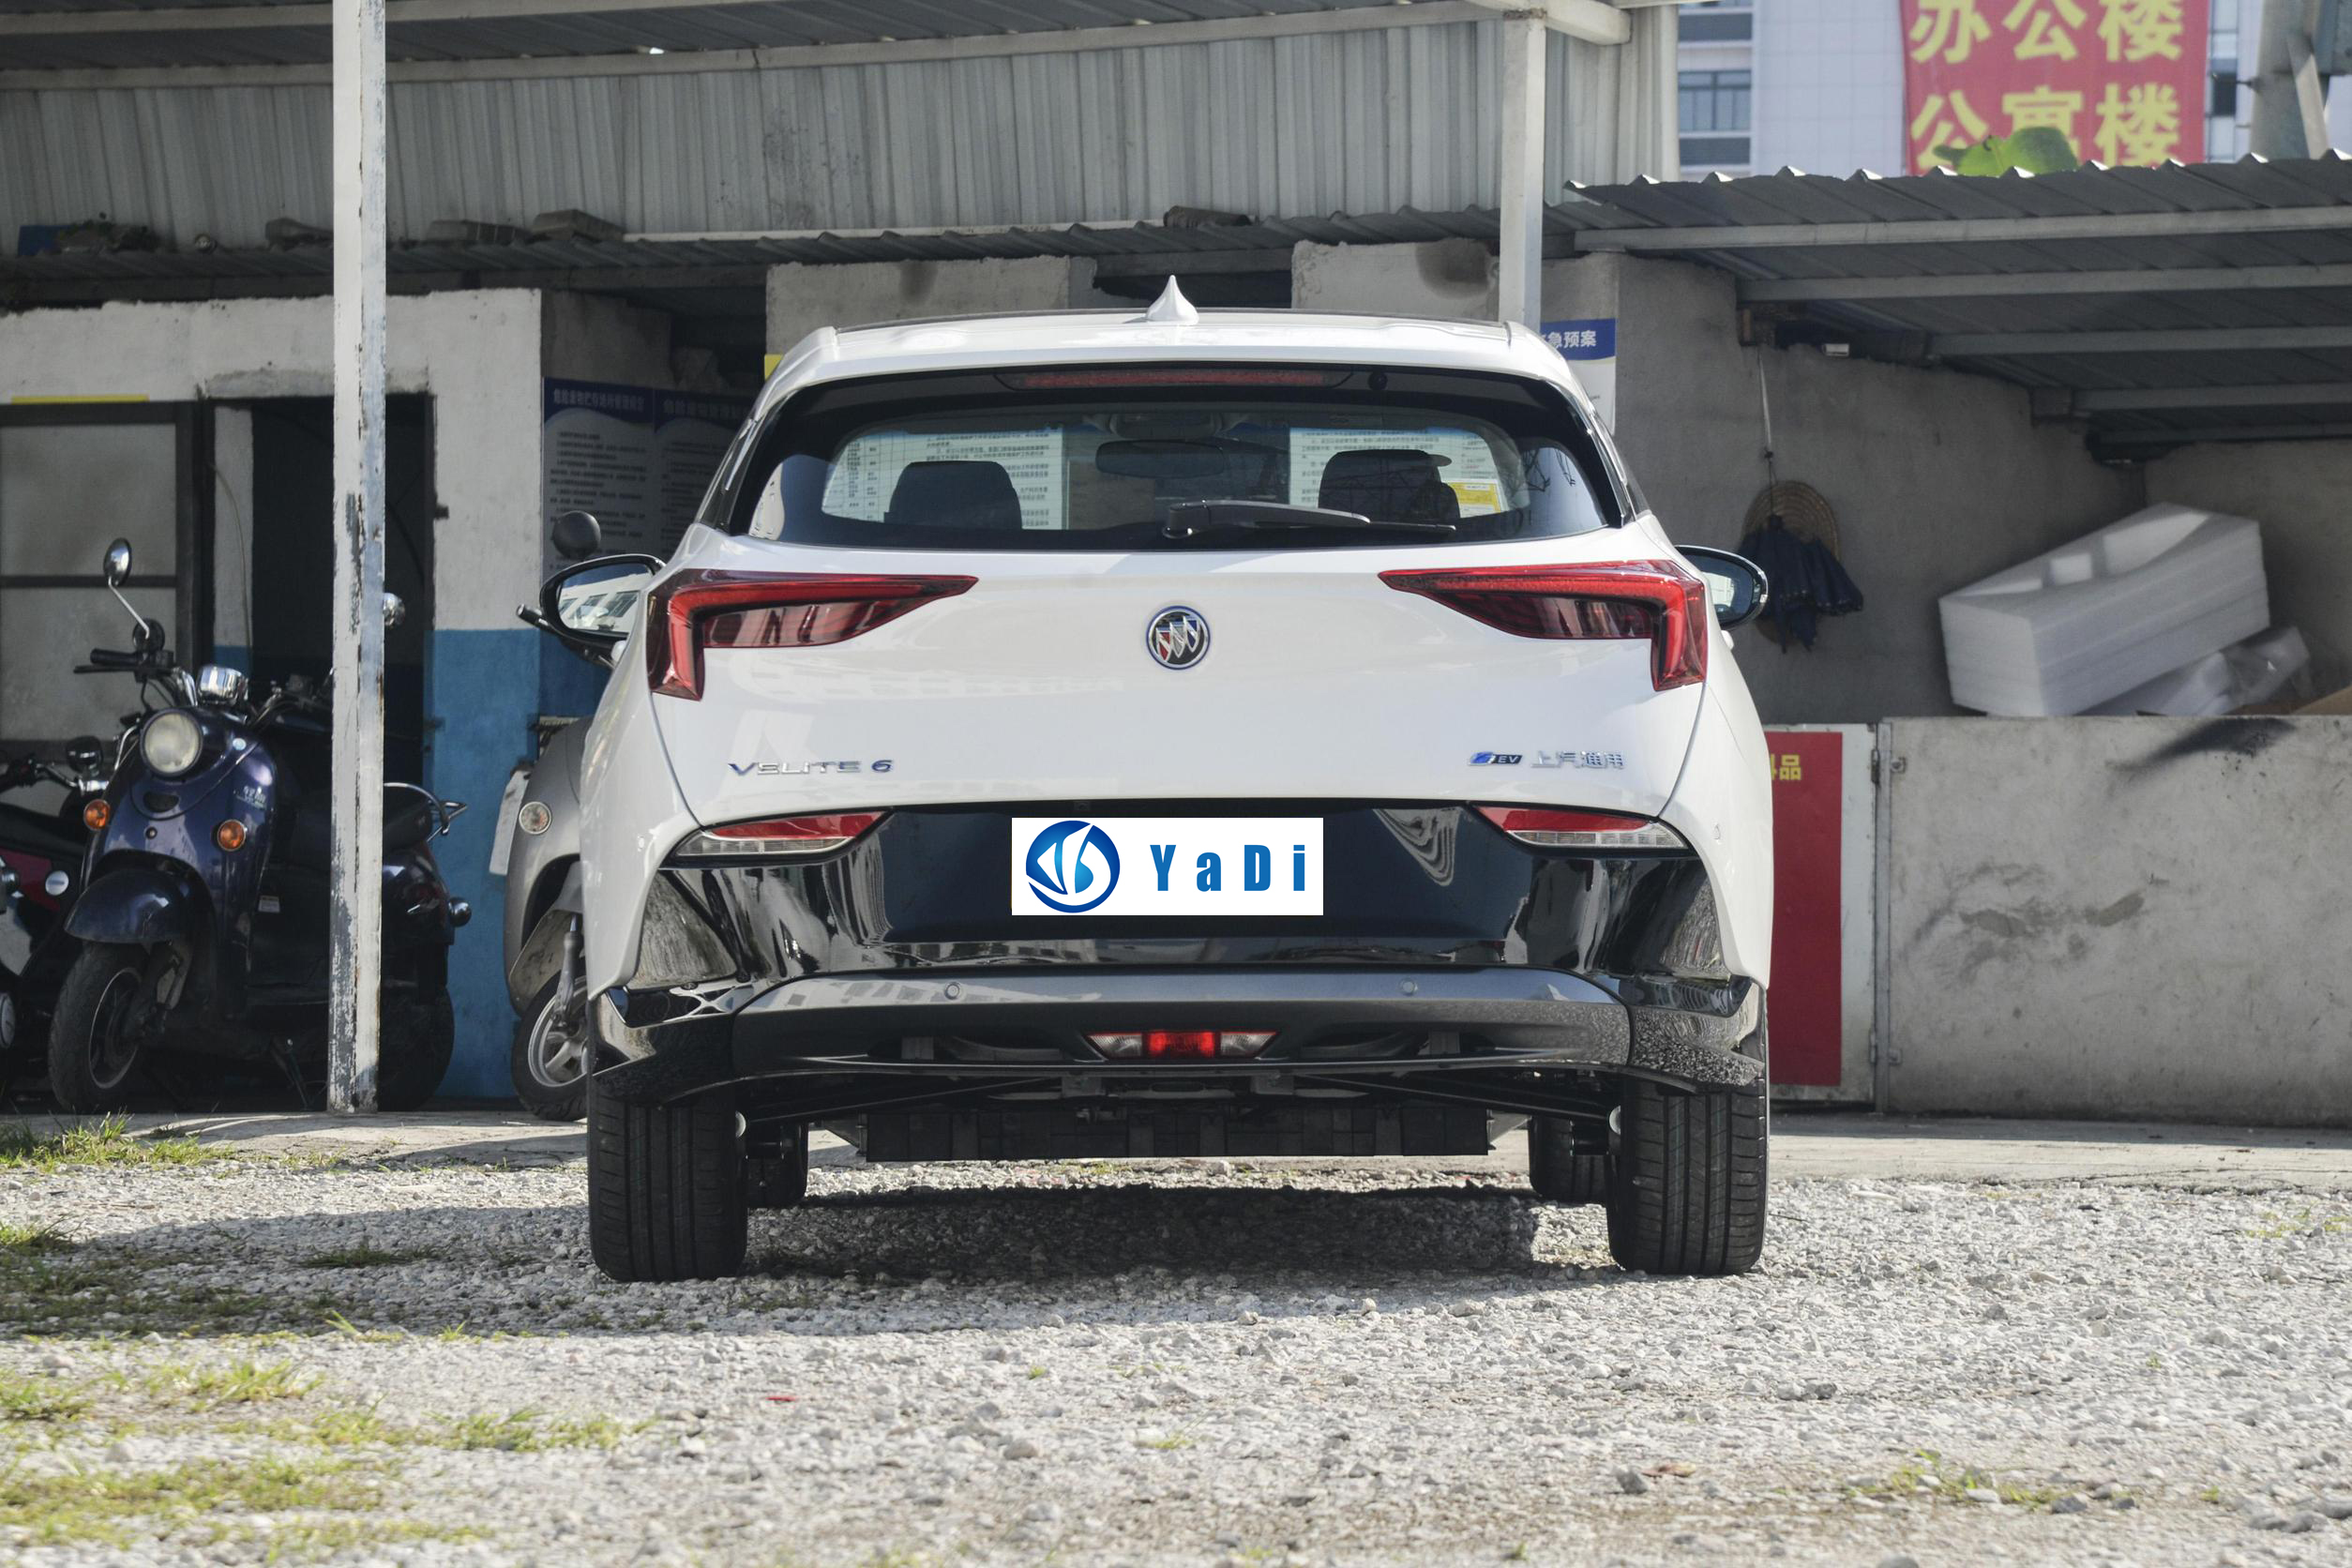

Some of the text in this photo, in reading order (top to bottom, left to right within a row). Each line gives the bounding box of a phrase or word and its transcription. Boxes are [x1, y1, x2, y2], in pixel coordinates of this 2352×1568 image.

[1541, 329, 1597, 350] 急预案
[871, 760, 893, 773] 6
